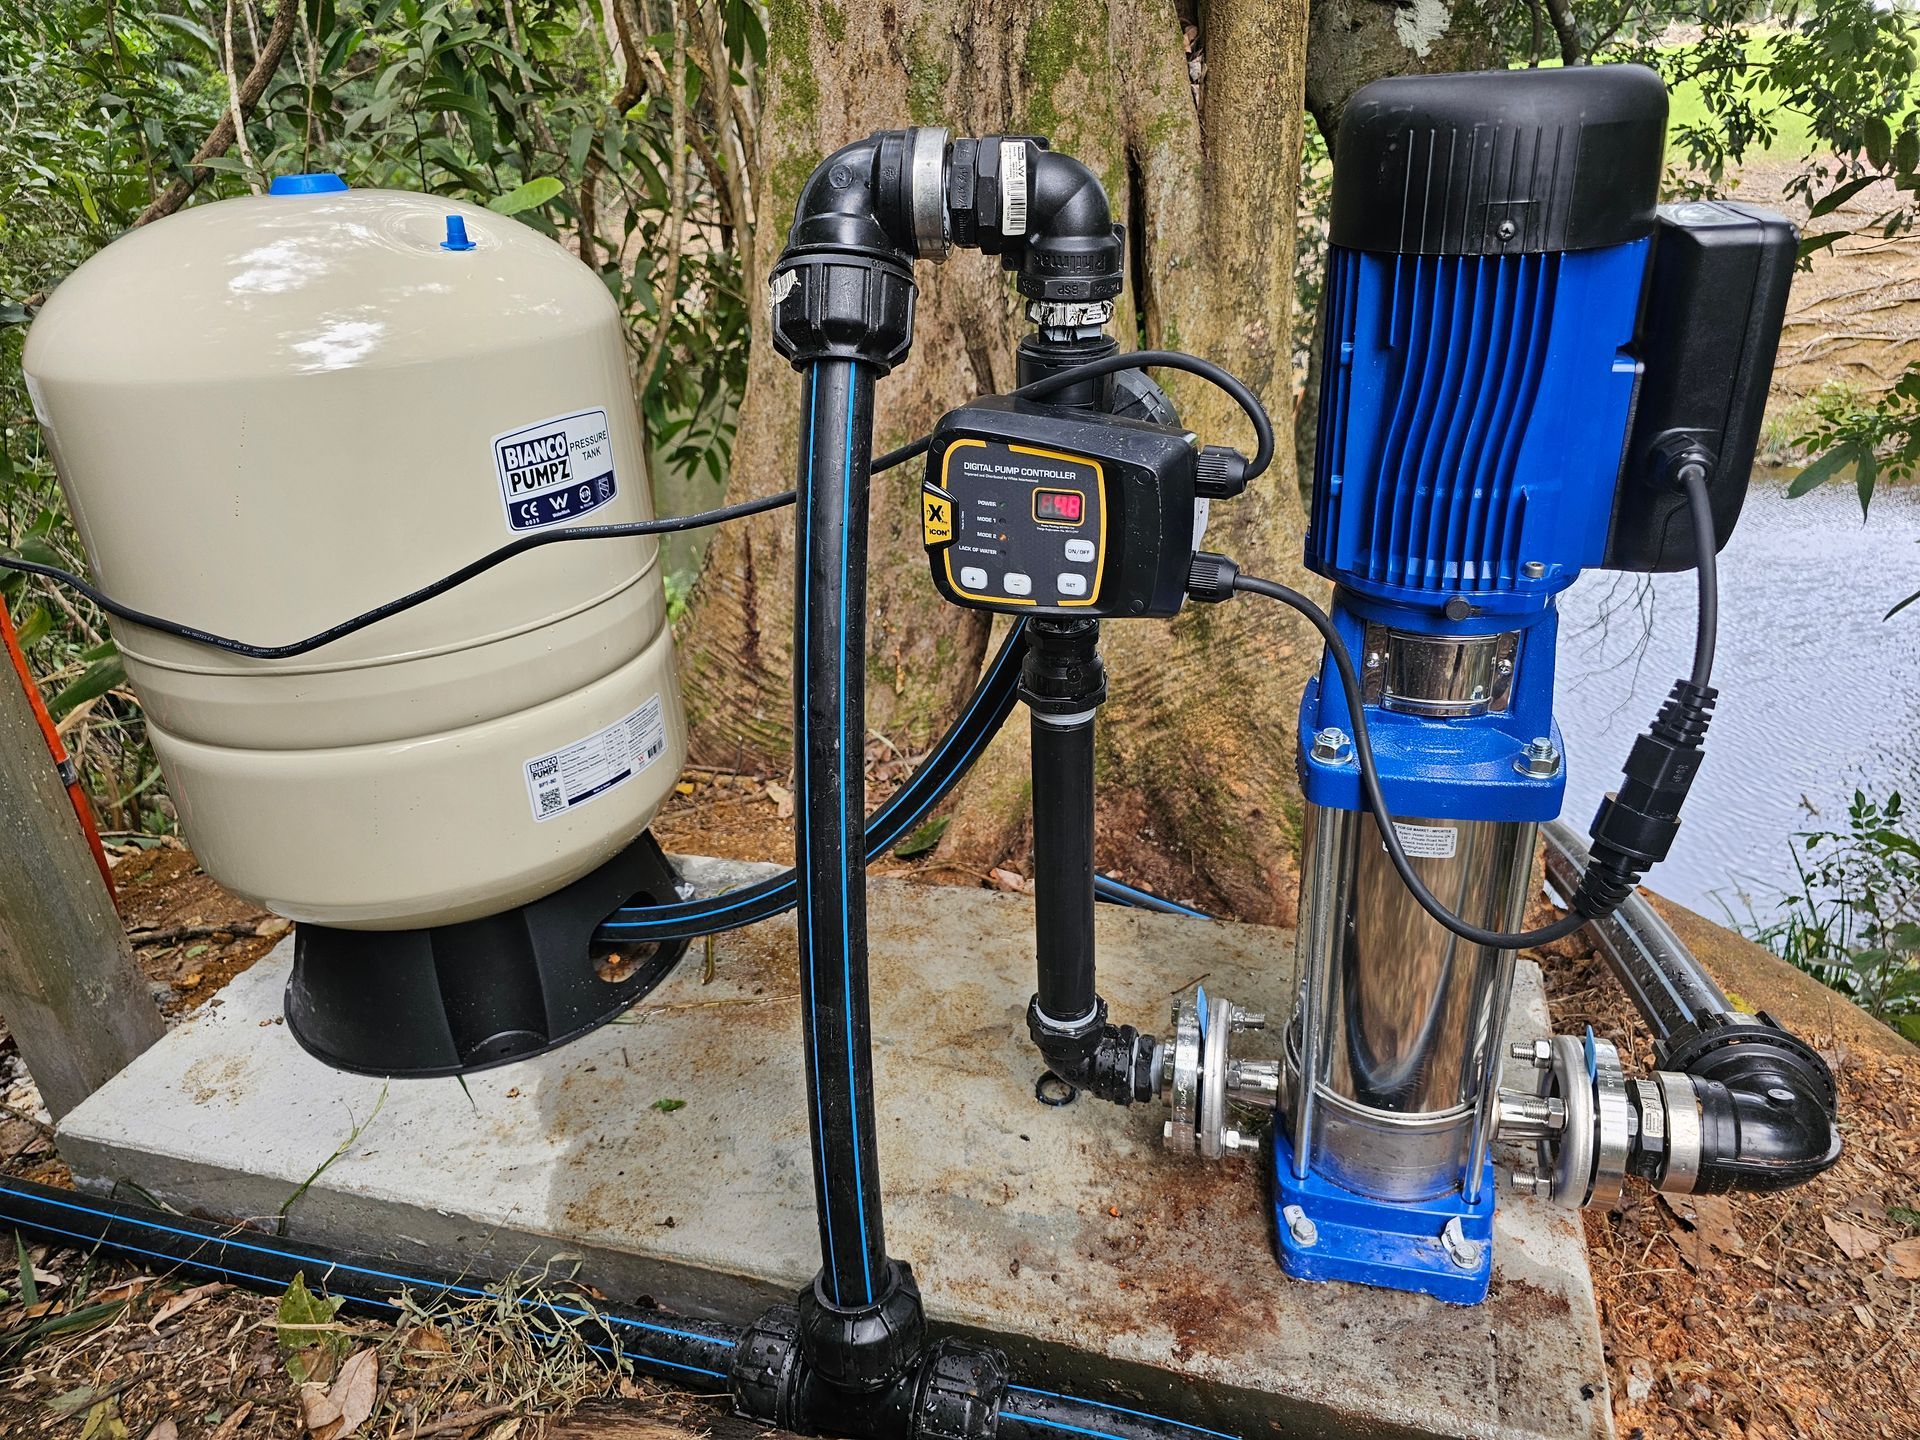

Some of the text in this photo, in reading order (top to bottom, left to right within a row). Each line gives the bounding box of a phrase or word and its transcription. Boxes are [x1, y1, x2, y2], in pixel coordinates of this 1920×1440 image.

[569, 430, 608, 452] PRESSURE
[504, 434, 566, 470] BIANCO
[582, 446, 602, 461] TANK
[510, 459, 571, 493] PUMPZ
[963, 461, 1077, 480] DIGITAL PUMP CONTROLLER
[977, 499, 997, 507] POWER
[530, 756, 558, 773] BIANCO
[532, 765, 559, 780] PUMPZ
